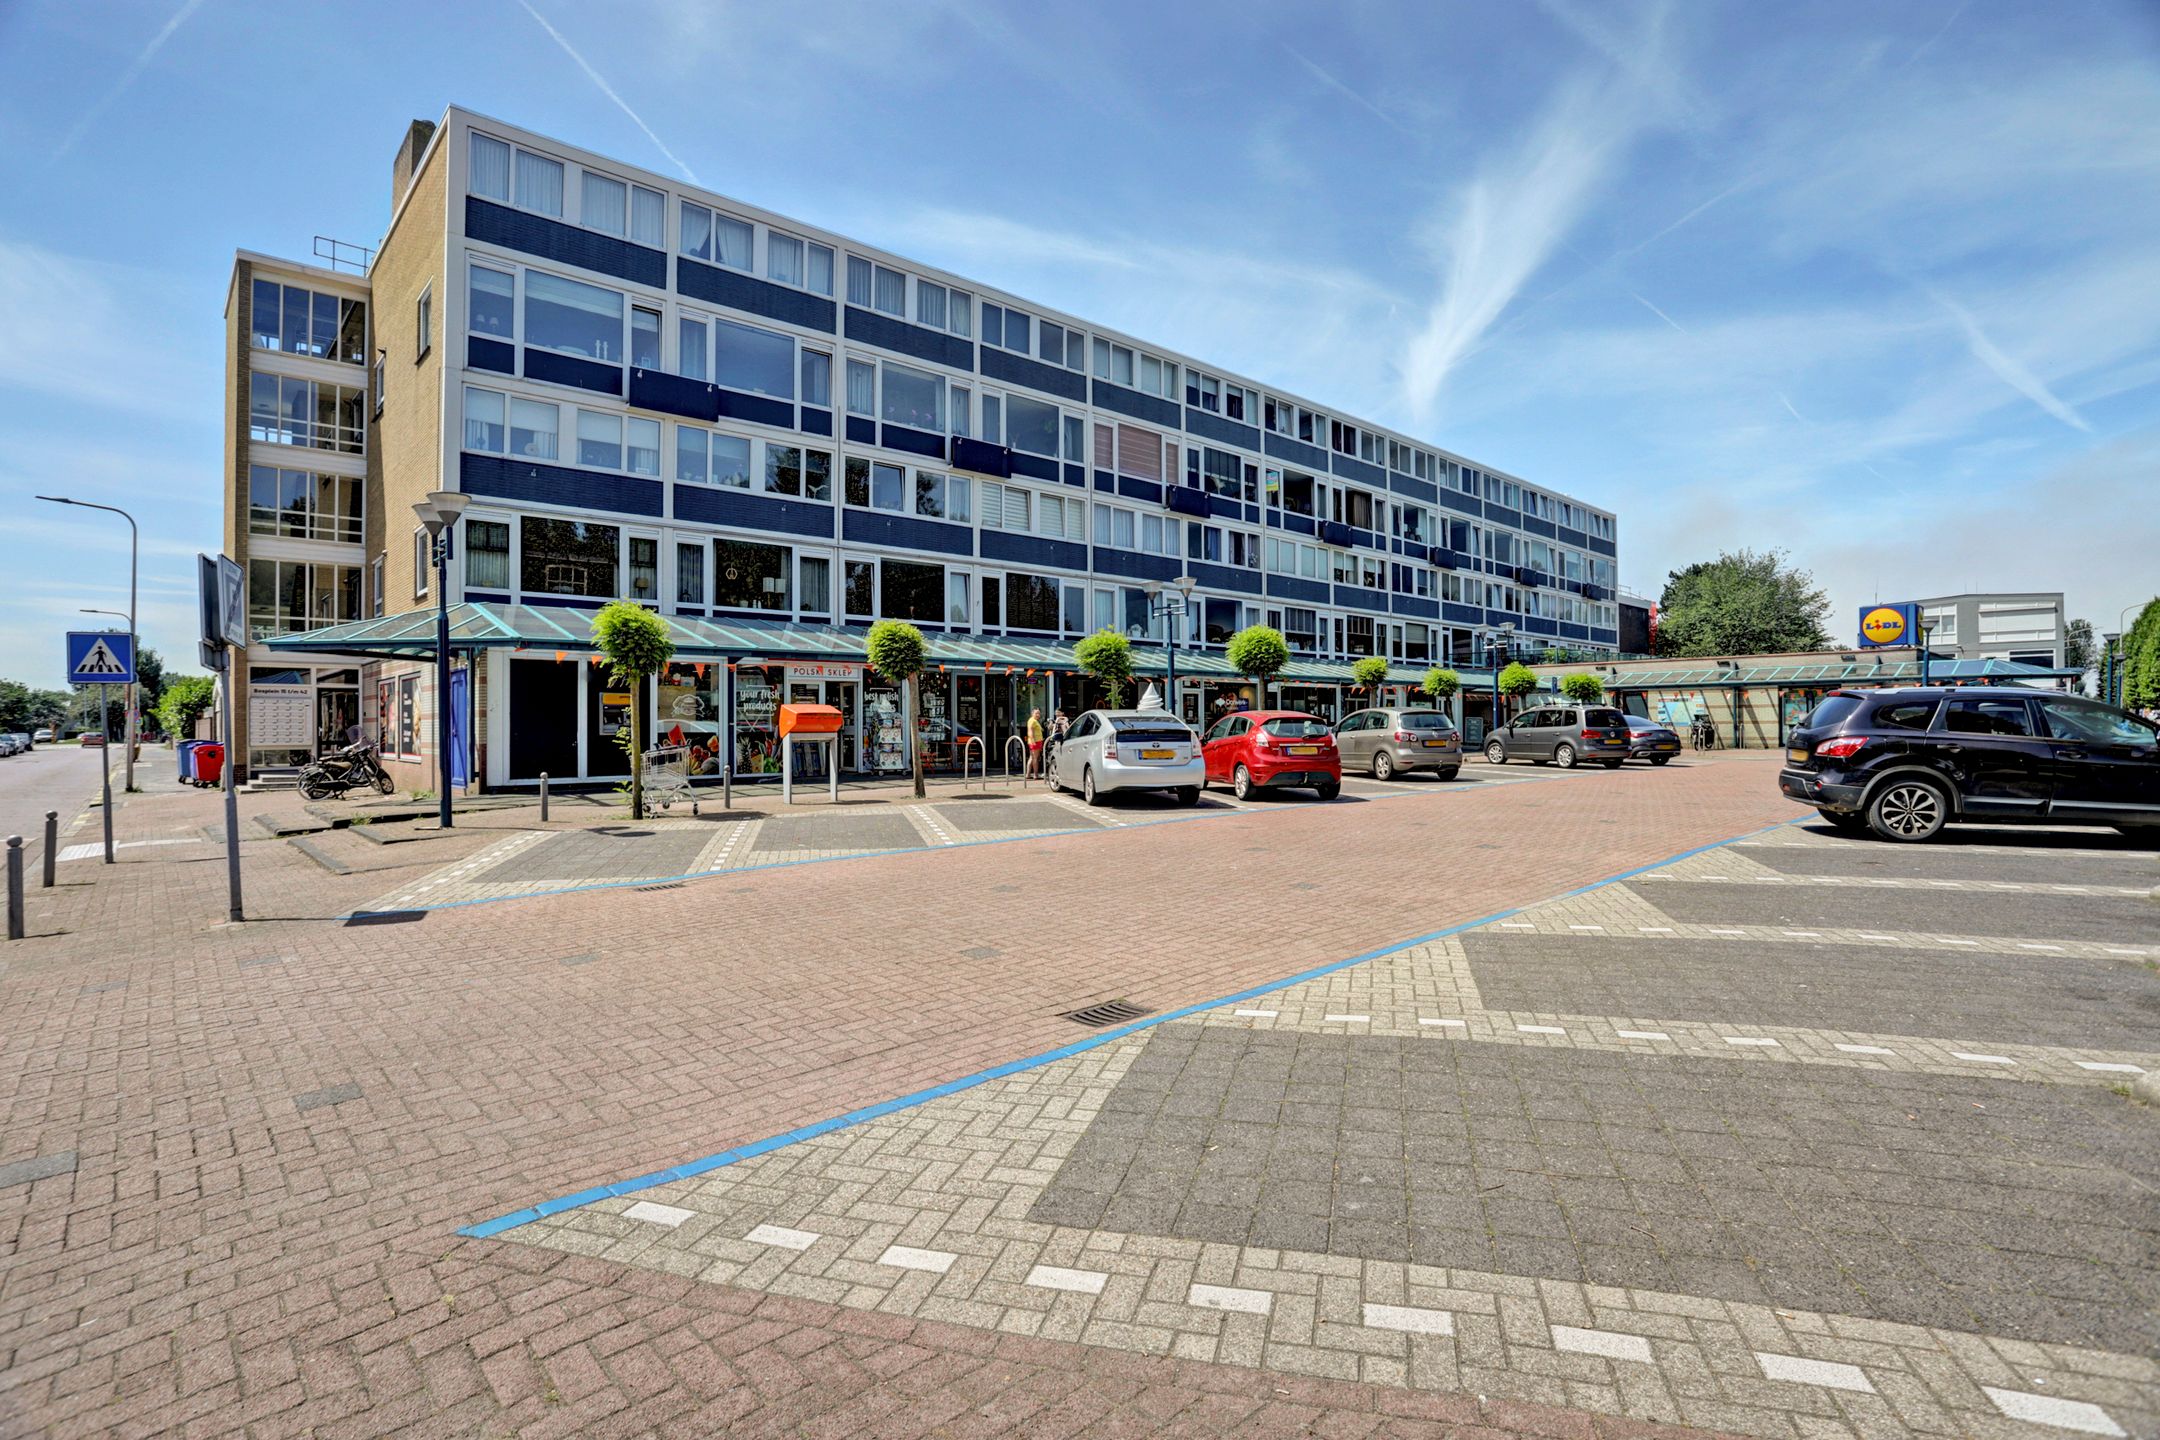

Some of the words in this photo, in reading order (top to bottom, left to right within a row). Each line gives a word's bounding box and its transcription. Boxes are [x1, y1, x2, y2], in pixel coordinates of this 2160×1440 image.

[740, 690, 758, 701] your
[759, 689, 780, 700] fresh
[864, 691, 879, 702] best
[743, 701, 777, 712] products
